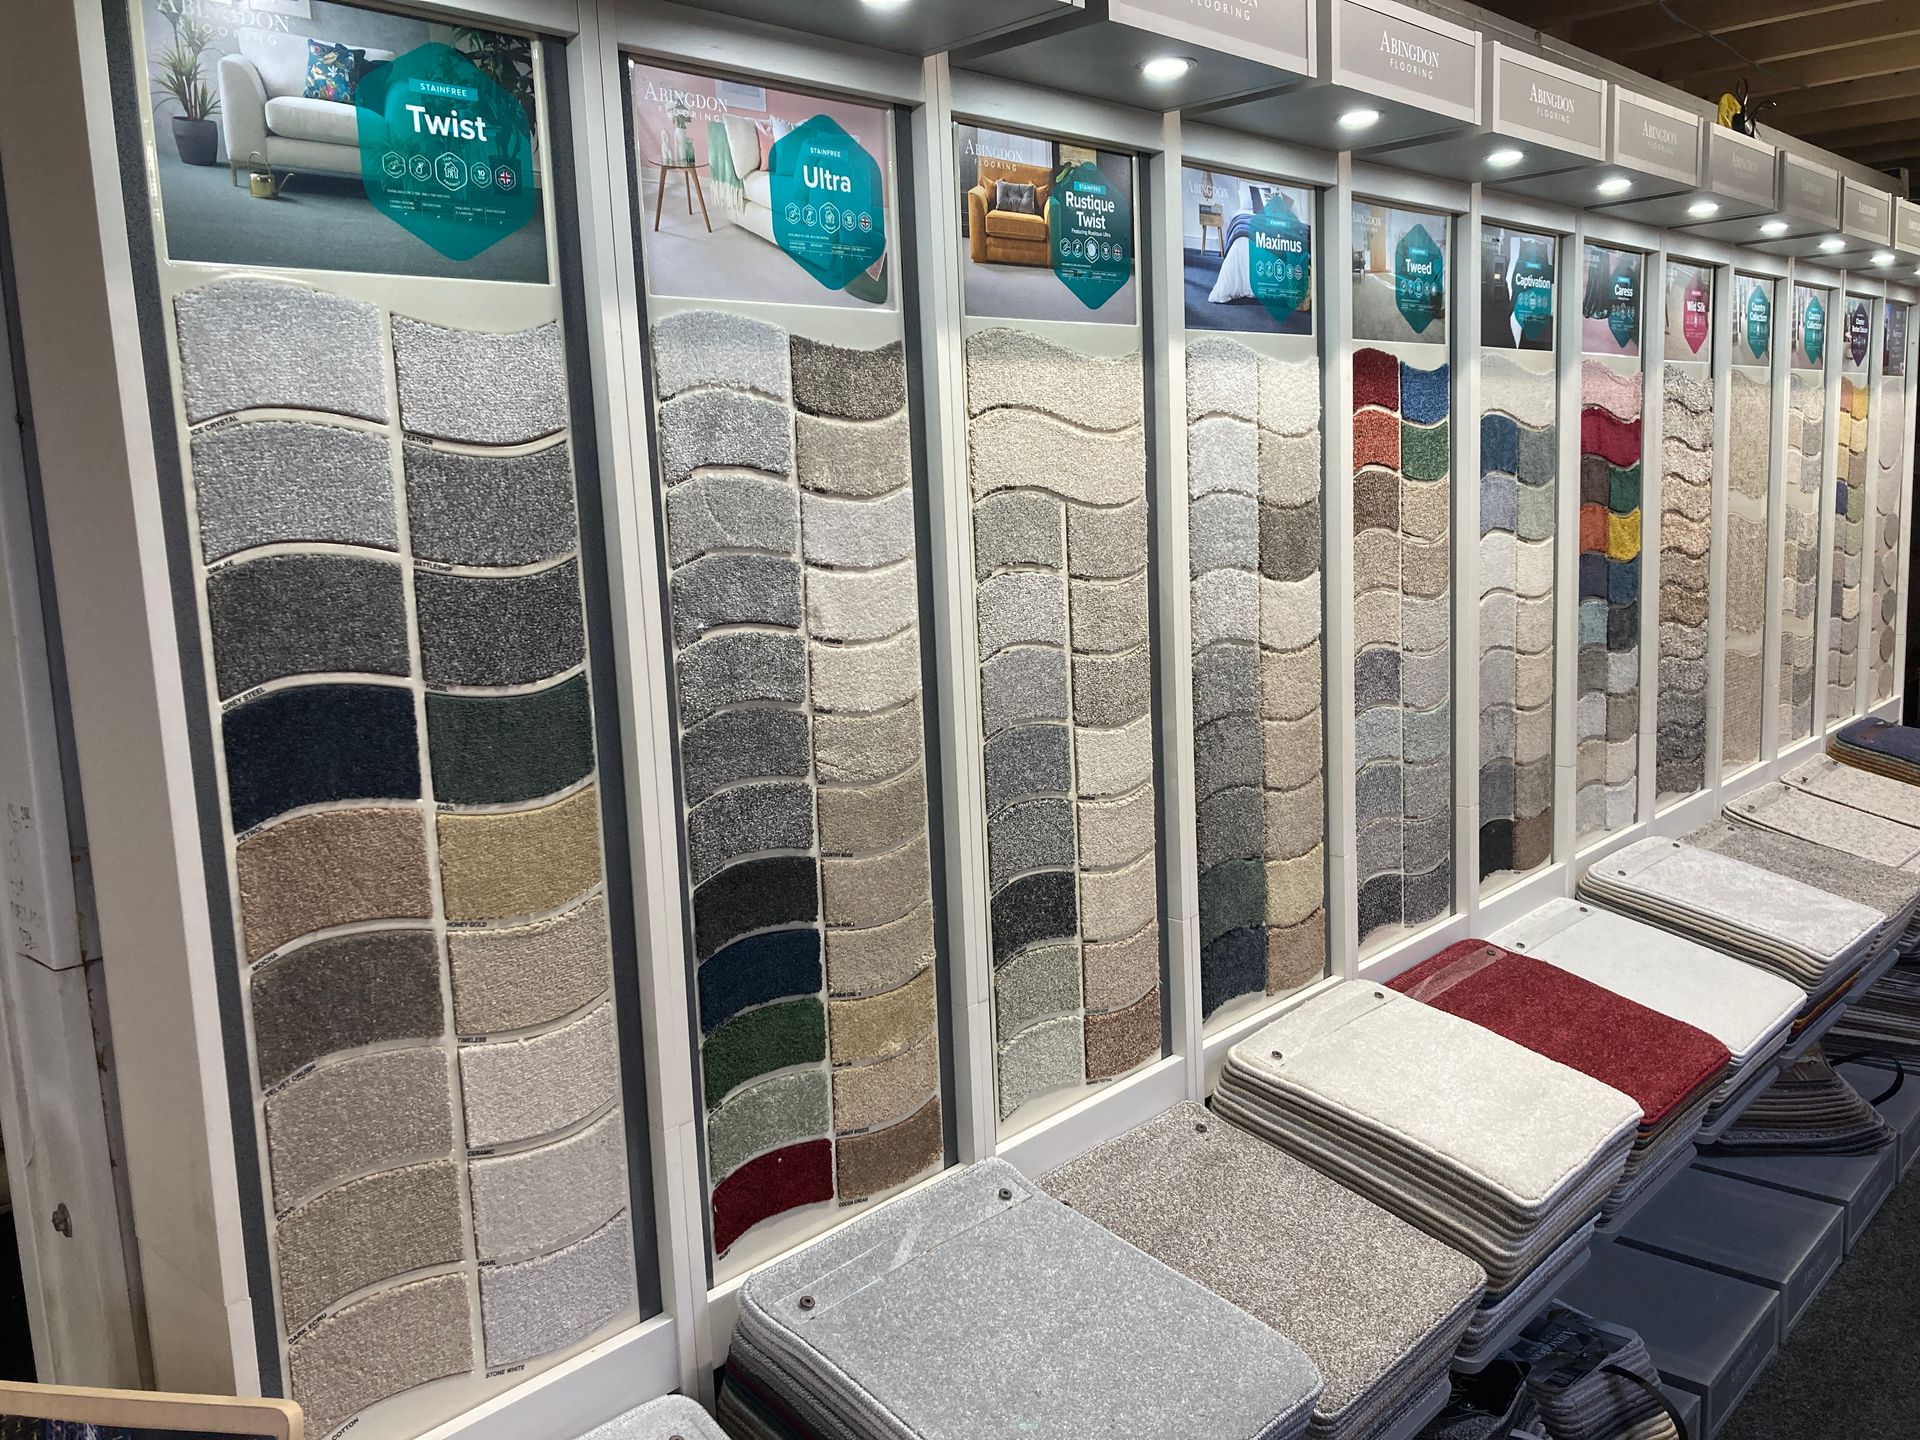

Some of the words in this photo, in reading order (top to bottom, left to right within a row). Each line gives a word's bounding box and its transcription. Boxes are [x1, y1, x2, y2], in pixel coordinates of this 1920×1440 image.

[1380, 29, 1439, 68] ABINGDON
[1390, 58, 1433, 80] FLOORING
[420, 82, 467, 97] STAINFREE
[644, 81, 728, 112] ABINGDON
[1530, 83, 1575, 113] ABINGDON
[405, 104, 488, 142] Twist
[1536, 106, 1570, 124] FLOORING
[1642, 120, 1677, 144] ABINGDON
[810, 147, 841, 158] STAINFREE
[965, 138, 1024, 162] ABINGDON
[974, 158, 1017, 172] FLOORING
[802, 164, 852, 193] Ultra
[1065, 190, 1115, 215] Rustique
[1076, 210, 1106, 230] Twist
[1255, 231, 1303, 253] Maximus
[1405, 258, 1432, 275] Tweed
[1515, 272, 1550, 289] Captivation
[1614, 283, 1633, 297] Caress
[190, 427, 203, 436] ICE
[205, 415, 239, 433] CRYSTAL
[403, 433, 433, 446] FEATHER
[414, 560, 453, 573] BATTLESHIP
[425, 684, 448, 693] FOSSIL
[222, 697, 242, 710] GREY
[243, 687, 266, 701] STEEL
[437, 804, 455, 812] BASIL
[237, 825, 265, 843] PETROL
[251, 952, 279, 971] MOCHA
[265, 1080, 291, 1098] VELVET
[291, 1064, 317, 1082] CRUSH
[467, 1149, 495, 1157] CERAMIC
[839, 1200, 854, 1208] COCOA
[288, 1328, 307, 1345] DARK
[307, 1312, 327, 1330] ECRU
[486, 1368, 505, 1378] STONE
[507, 1364, 525, 1373] WHITE
[332, 1417, 359, 1440] COTTON
